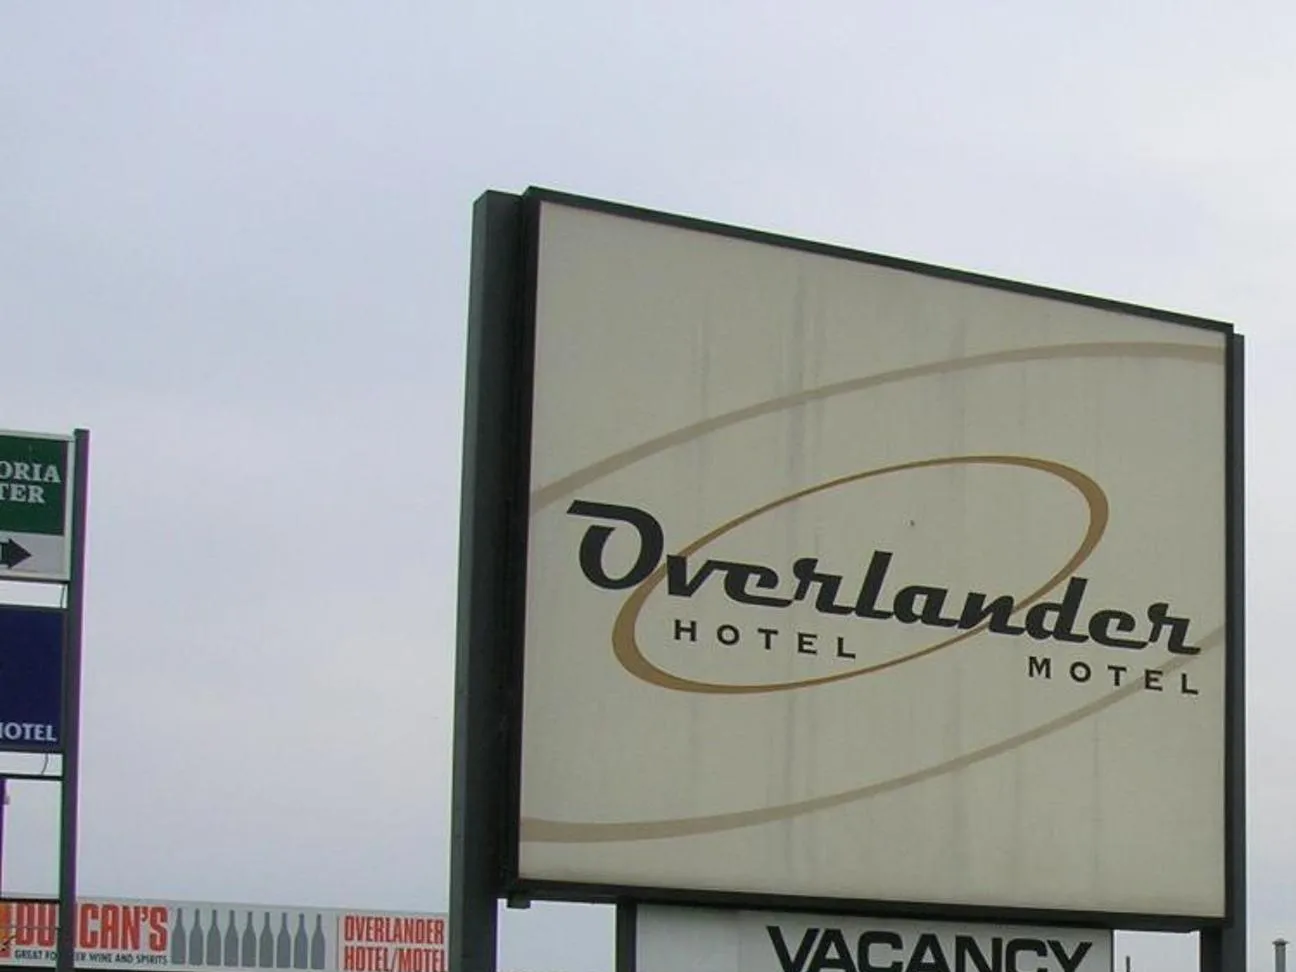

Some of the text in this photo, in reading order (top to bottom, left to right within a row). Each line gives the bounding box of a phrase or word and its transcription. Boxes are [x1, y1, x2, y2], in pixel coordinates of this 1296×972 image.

[567, 500, 1201, 656] Overlander
[674, 620, 857, 660] HOTEL
[1028, 656, 1199, 695] MOTEL
[16, 903, 168, 951] DUCAN'S
[344, 915, 445, 944] OVERLANDER
[89, 952, 113, 963] WINE
[115, 953, 134, 964] AND
[136, 954, 168, 966] SPIRITS
